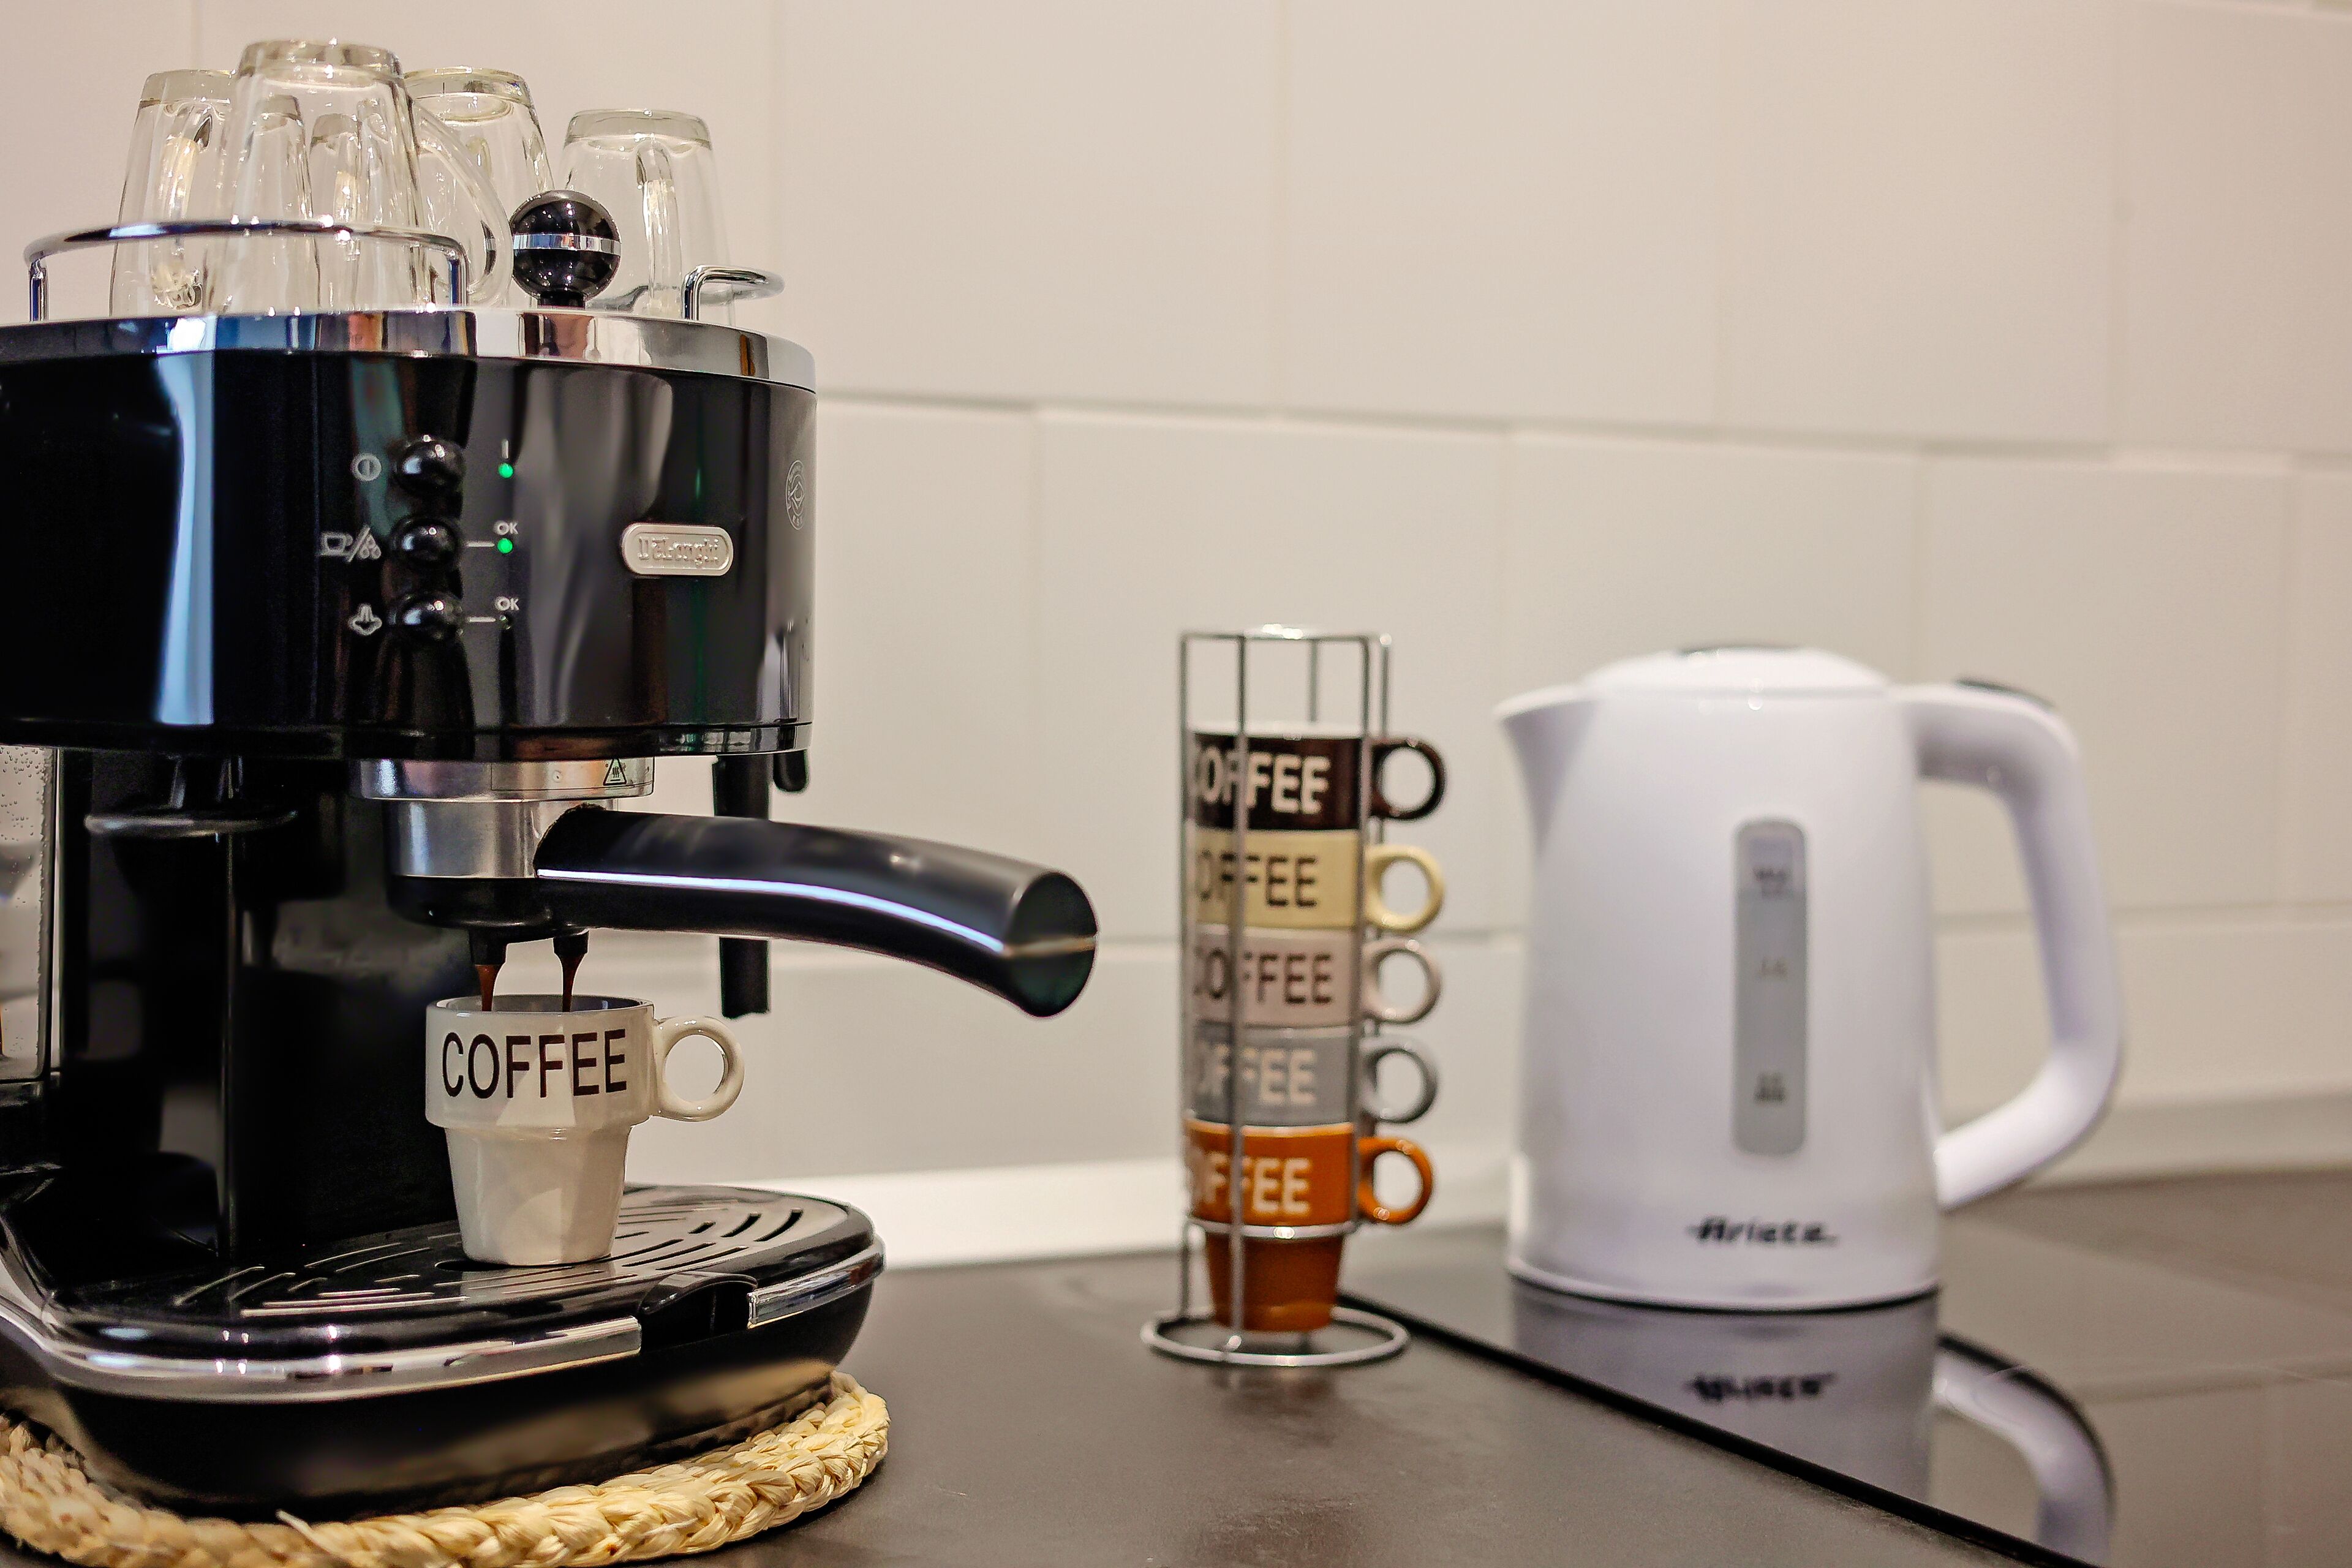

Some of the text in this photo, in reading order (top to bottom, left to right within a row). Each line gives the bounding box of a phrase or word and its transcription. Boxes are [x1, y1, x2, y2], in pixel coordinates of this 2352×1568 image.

[494, 521, 519, 536] OK
[495, 597, 519, 611] OK
[1191, 746, 1332, 815] OFFEE
[1191, 848, 1317, 907] OFFEE
[442, 1028, 627, 1099] COFFEE
